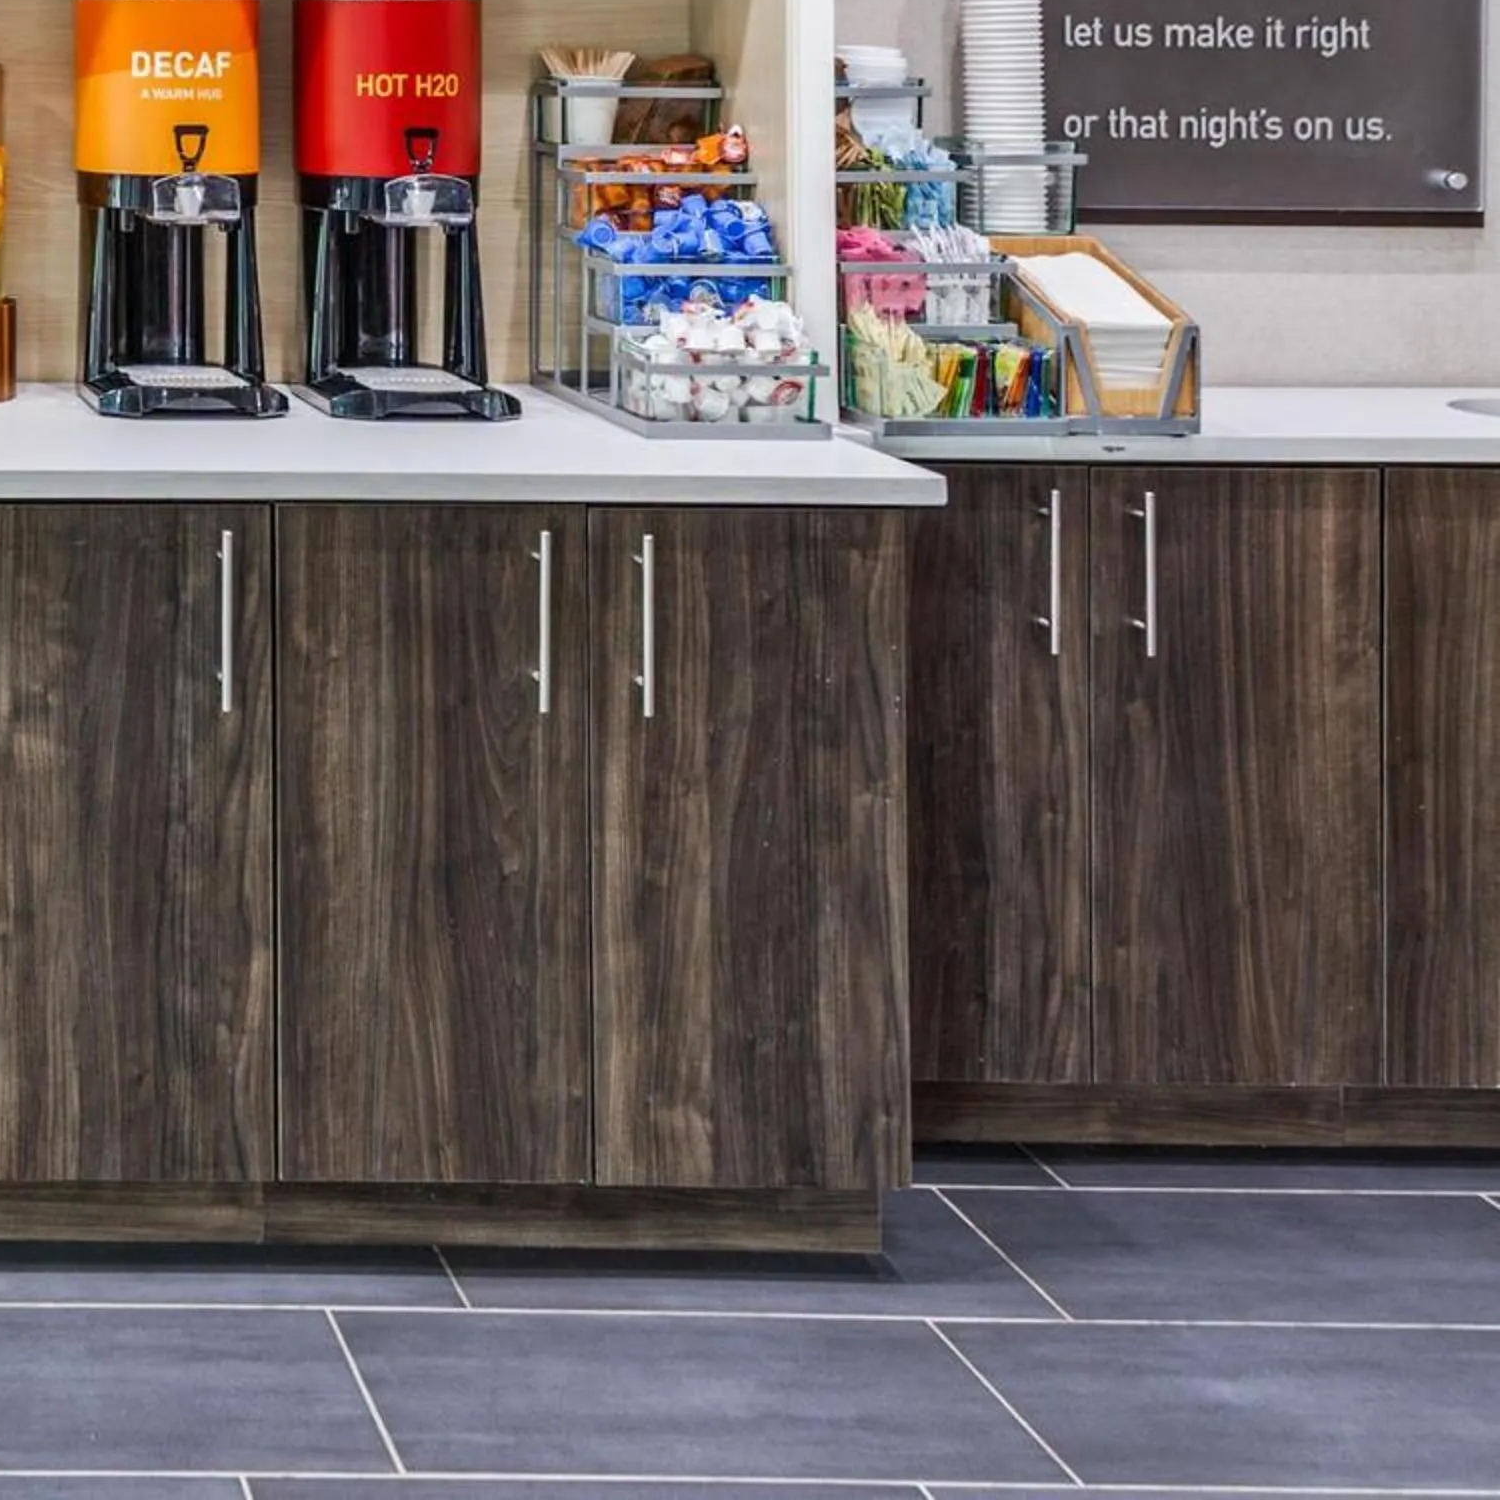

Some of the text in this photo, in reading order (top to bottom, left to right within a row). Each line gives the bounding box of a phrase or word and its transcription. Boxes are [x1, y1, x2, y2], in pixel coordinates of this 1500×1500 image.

[1065, 15, 1370, 58] let us make it right
[131, 51, 231, 79] DECAF
[140, 87, 223, 101] A WARM HUG
[356, 73, 408, 98] HOT
[1063, 107, 1393, 149] or that night's on us.
